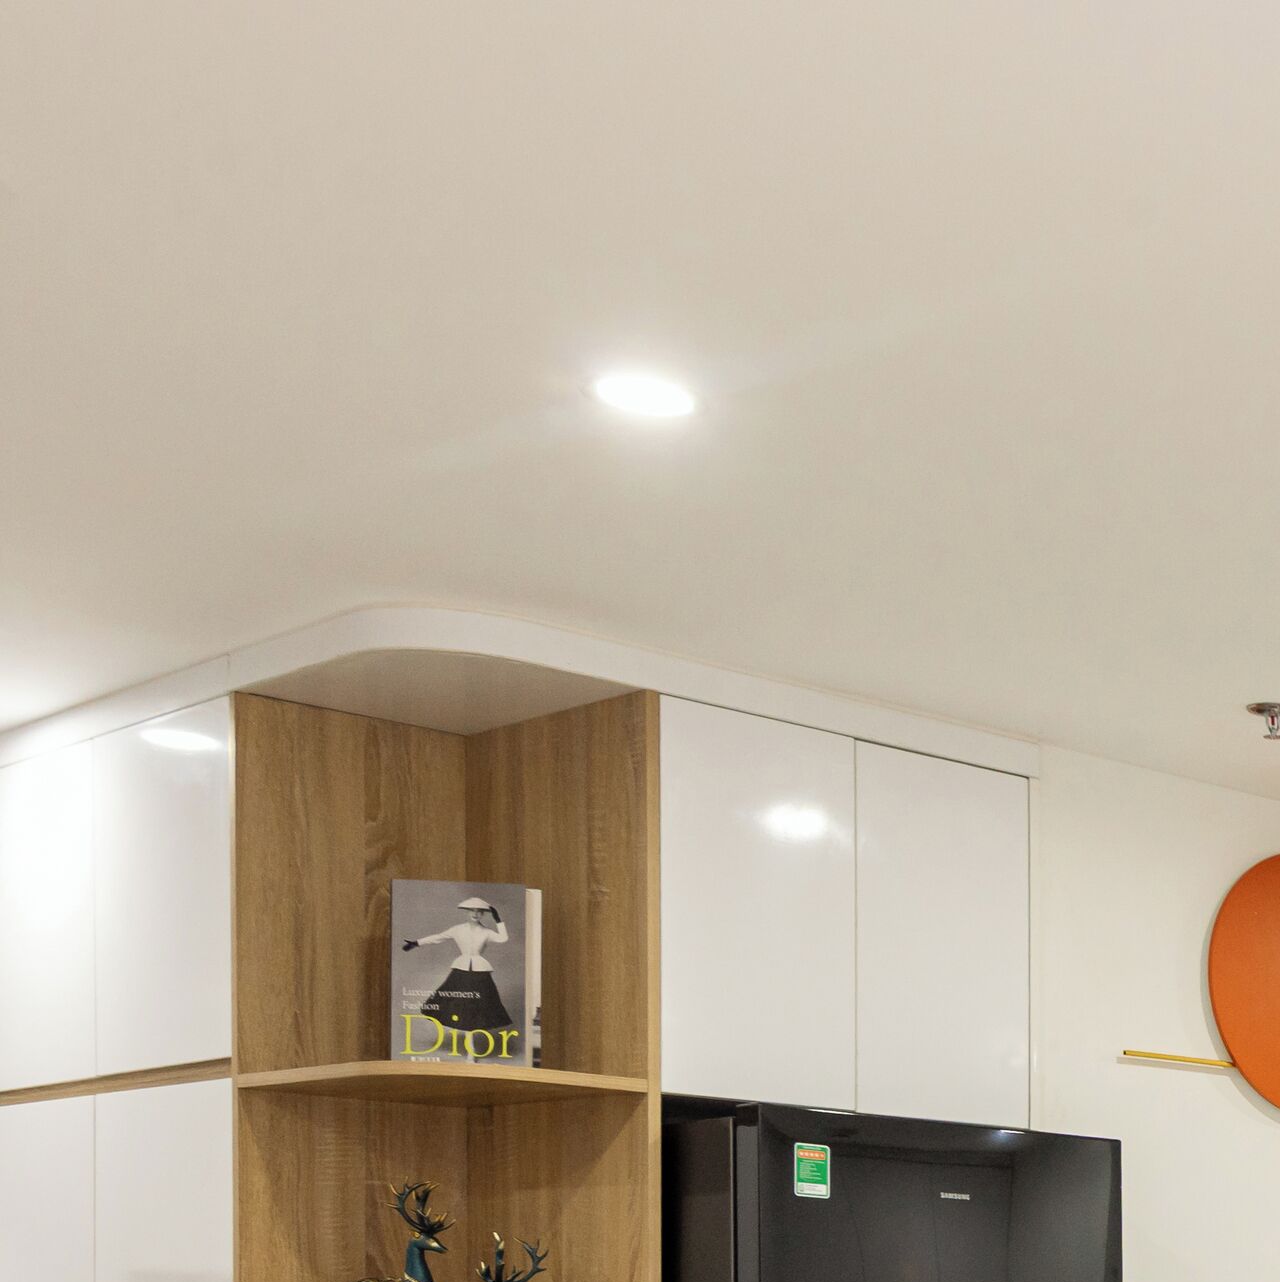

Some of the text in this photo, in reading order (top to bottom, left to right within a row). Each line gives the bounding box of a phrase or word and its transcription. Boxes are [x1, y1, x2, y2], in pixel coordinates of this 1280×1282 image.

[402, 986, 481, 999] Luxury women's
[402, 1000, 440, 1010] Fashion
[399, 1013, 519, 1059] Dior
